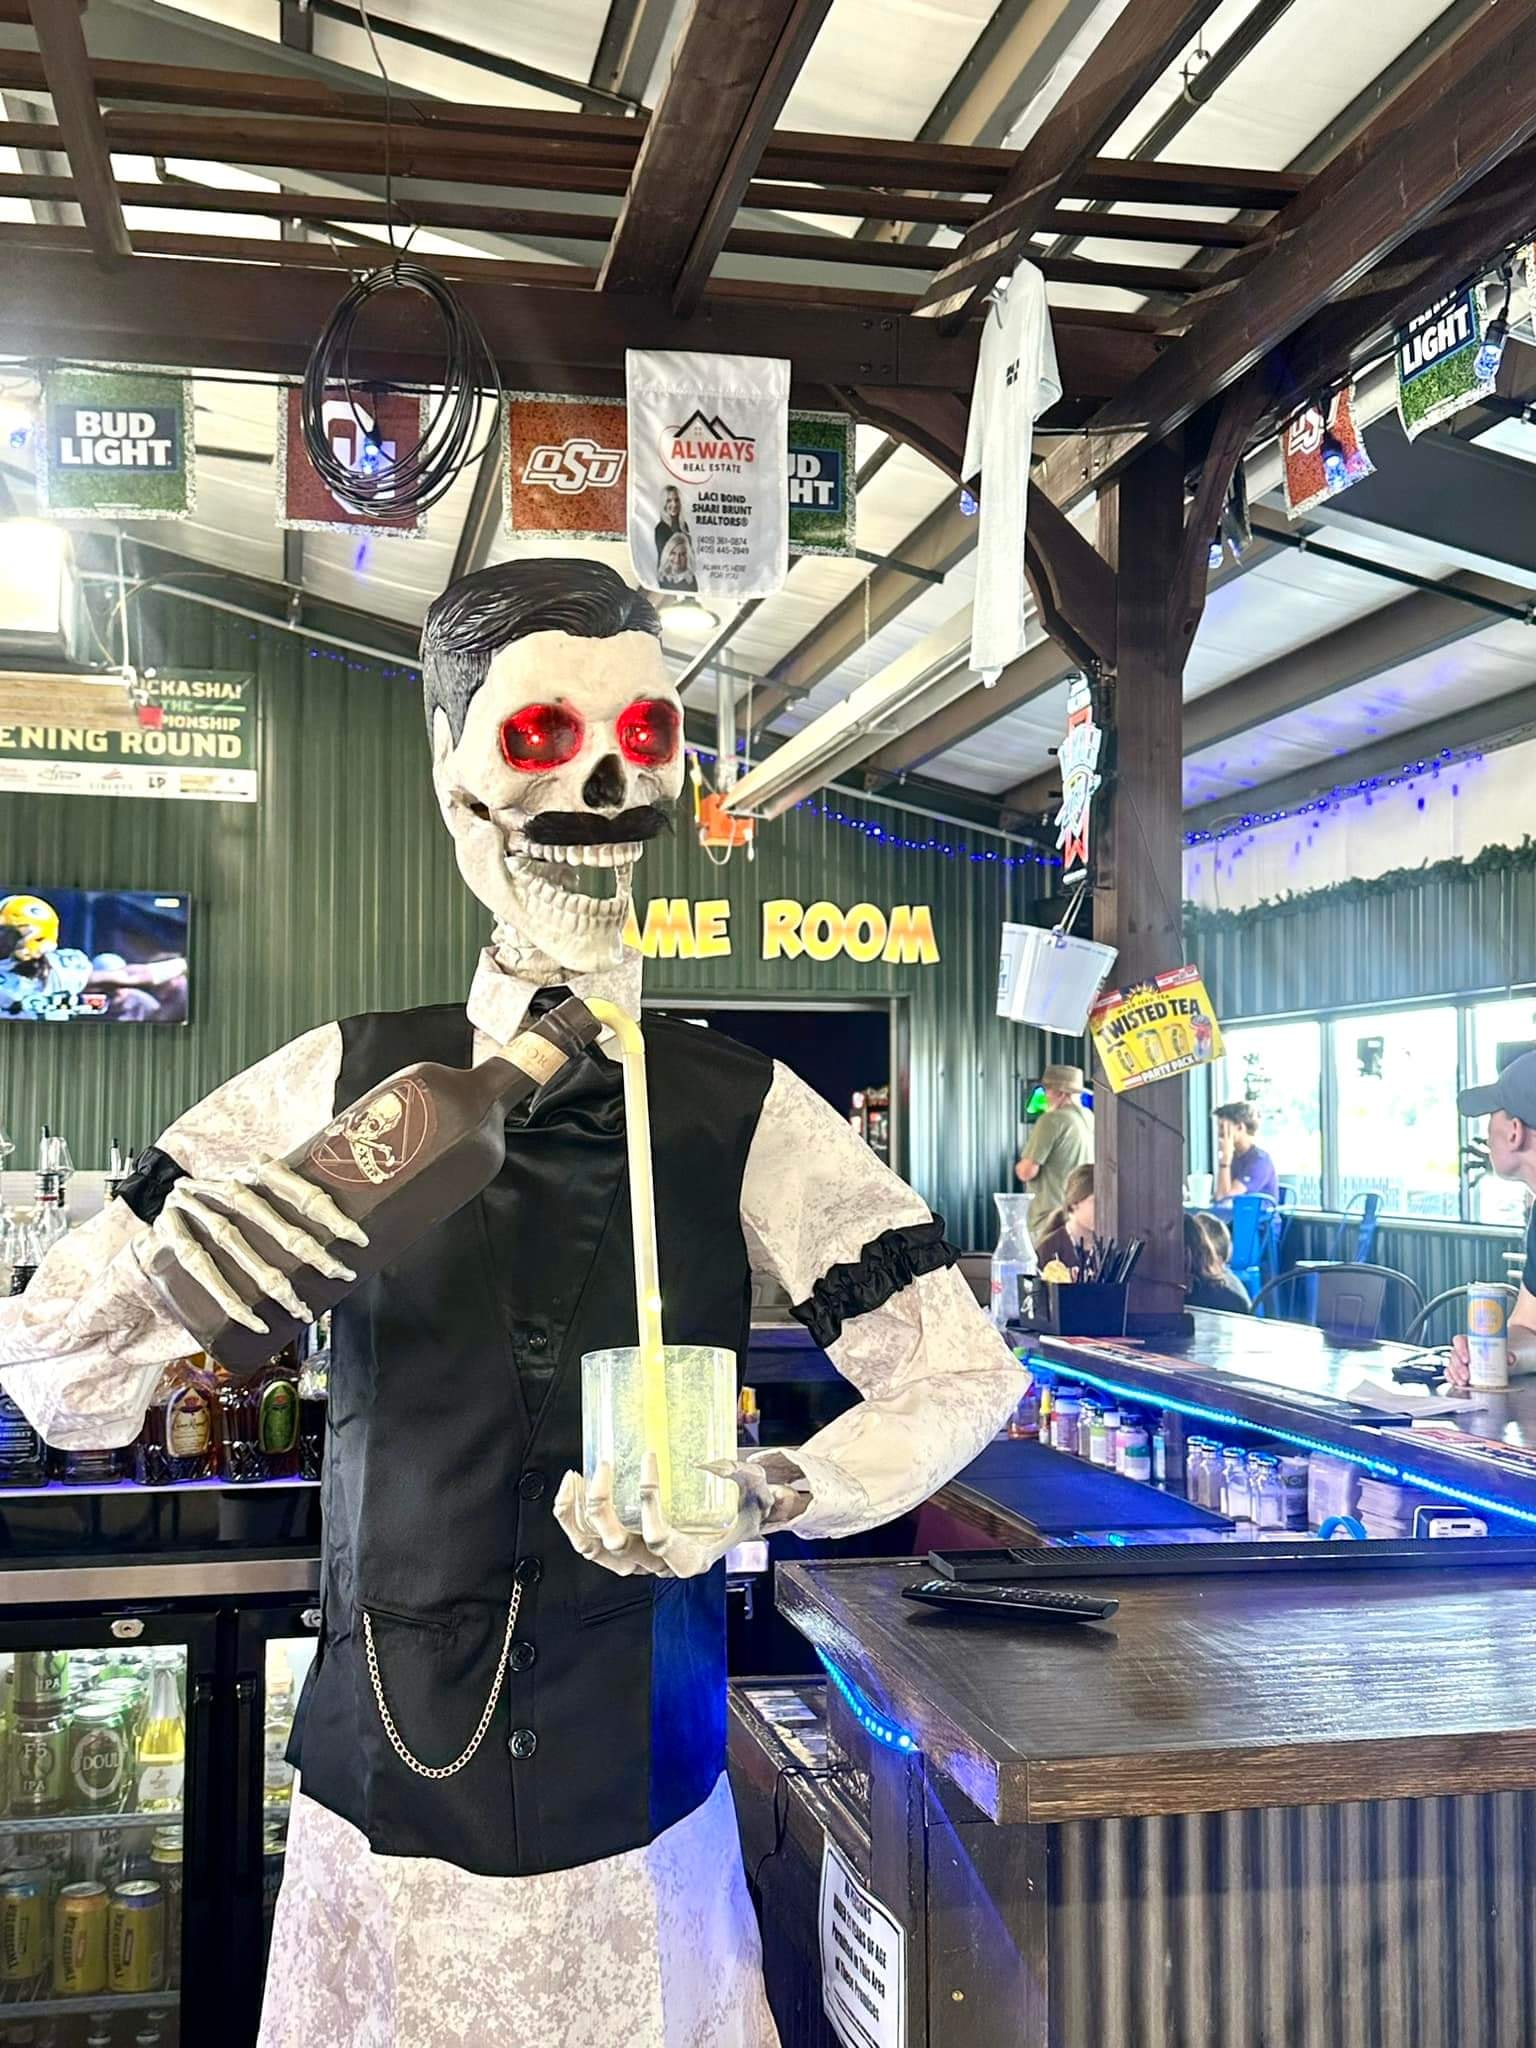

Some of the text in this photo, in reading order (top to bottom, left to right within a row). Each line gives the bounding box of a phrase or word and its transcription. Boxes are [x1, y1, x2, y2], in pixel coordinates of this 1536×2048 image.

[1402, 303, 1471, 376] LIGHT
[75, 410, 156, 438] BUD
[60, 438, 172, 467] LIGHT
[671, 440, 755, 464] ALWAYS
[522, 438, 627, 495] OSU
[683, 463, 741, 474] REAL ESTATE
[692, 503, 752, 516] SHARI BRUNT
[698, 491, 746, 504] LACI BOND
[160, 699, 193, 712] THE
[121, 731, 242, 759] ROUND
[762, 899, 940, 964] ROOM
[1096, 1001, 1168, 1045] TWISTED
[1168, 998, 1201, 1017] TEA
[1142, 1062, 1173, 1082] PARTY
[39, 1679, 60, 1690] IPA
[24, 1743, 48, 1759] F5
[23, 1780, 46, 1792] IPA
[875, 1944, 887, 1970] AGE
[872, 1970, 885, 1999] Area
